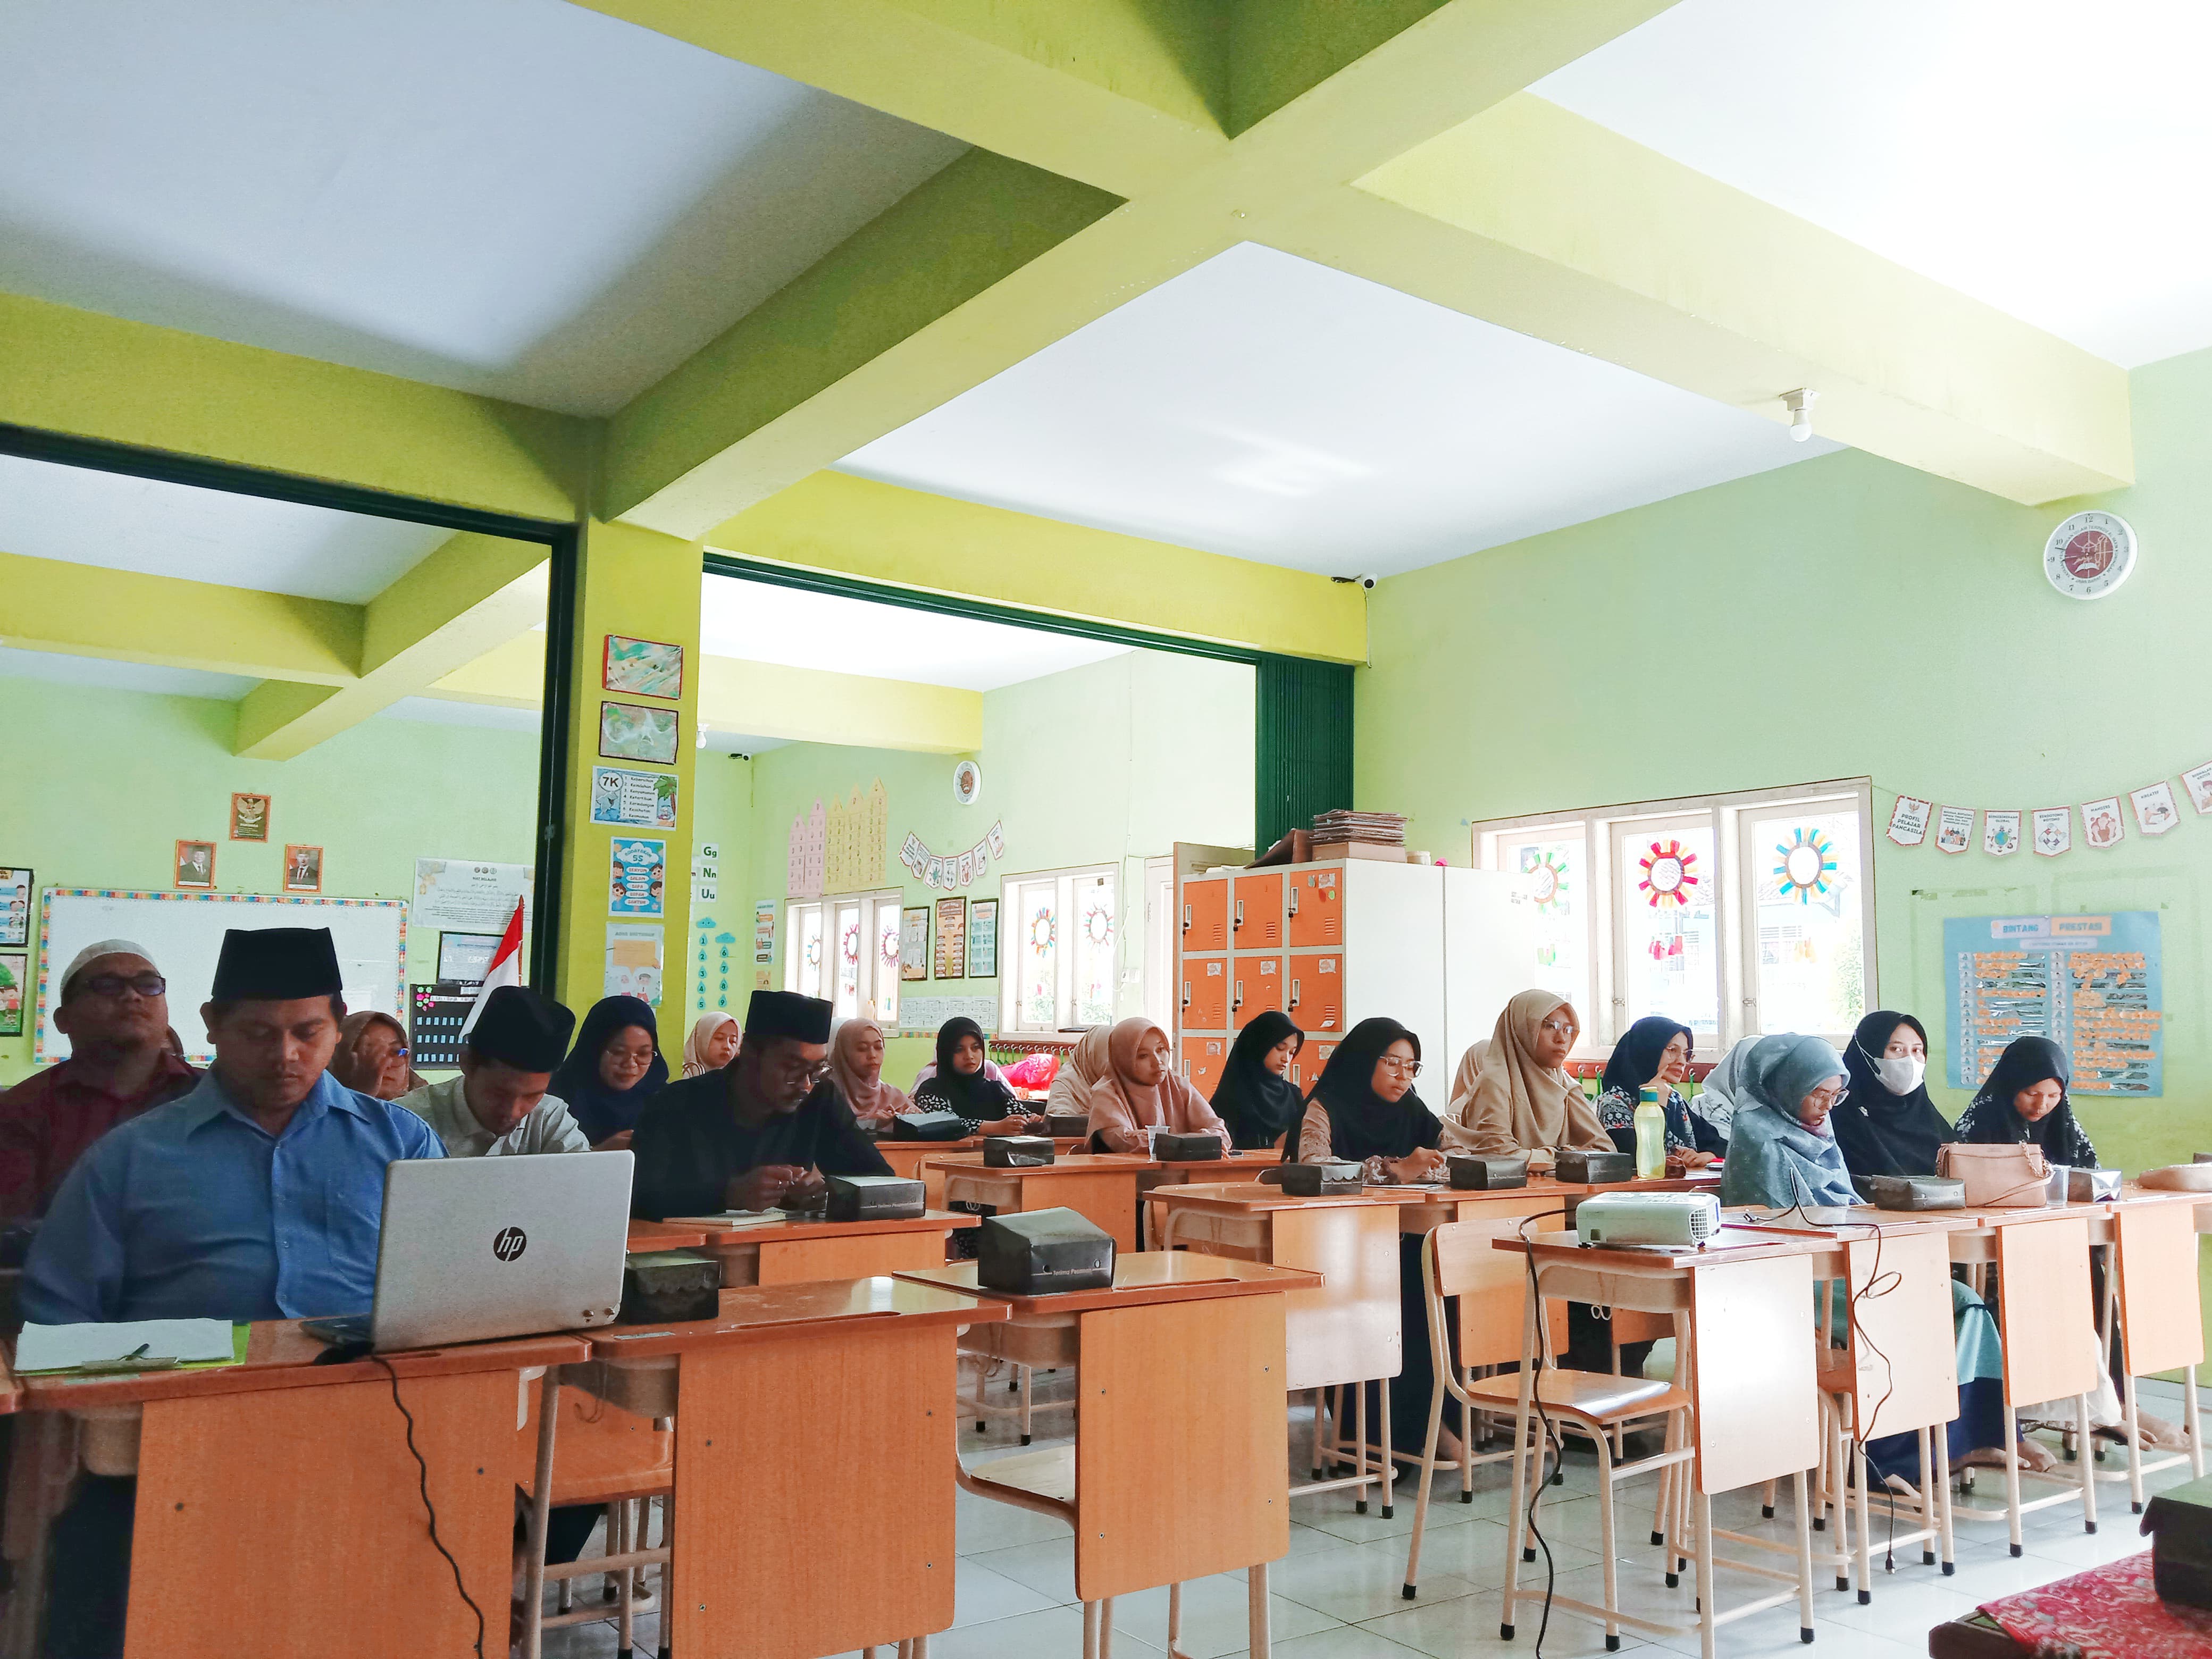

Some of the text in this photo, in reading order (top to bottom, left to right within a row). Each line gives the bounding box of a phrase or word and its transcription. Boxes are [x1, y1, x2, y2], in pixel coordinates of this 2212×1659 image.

[602, 776, 619, 787] 7K
[1901, 814, 1920, 822] PROFIL
[1897, 819, 1921, 828] PELAJAR
[1892, 824, 1922, 835] PANCASILA
[703, 847, 717, 858] Gg
[703, 867, 717, 878] Nn
[702, 889, 715, 899] Uu
[2003, 924, 2039, 933] BINTANG
[2059, 922, 2102, 931] PRESTASI
[497, 1227, 524, 1261] hp
